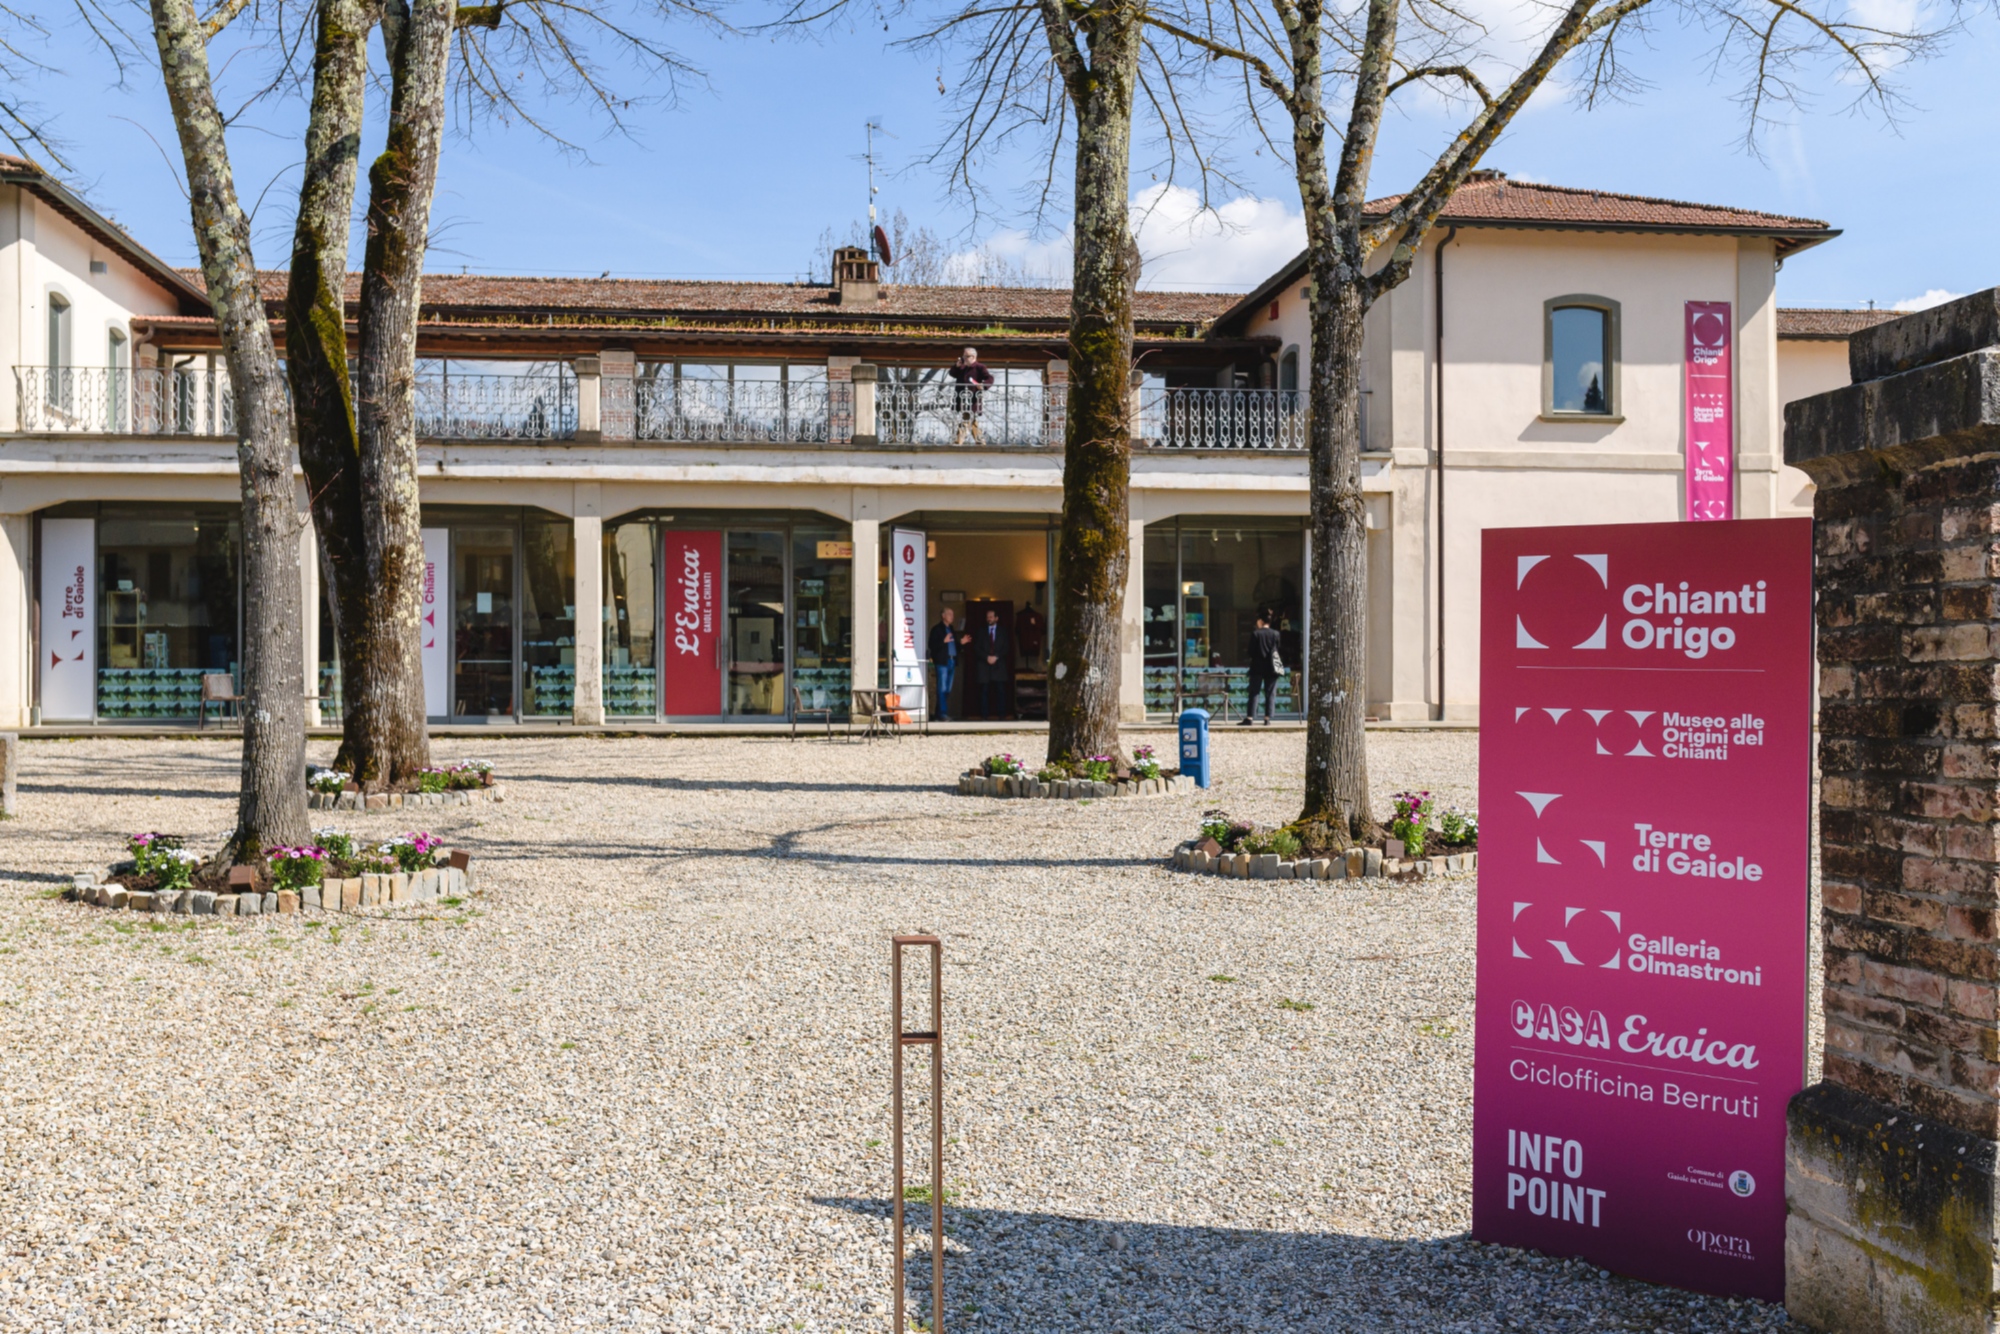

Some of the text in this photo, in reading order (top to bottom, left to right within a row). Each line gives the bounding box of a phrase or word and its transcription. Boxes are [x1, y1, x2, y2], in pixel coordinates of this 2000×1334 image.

[1693, 355, 1718, 366] Origo
[74, 565, 84, 619] di Gaiole
[424, 562, 435, 604] Chianti
[703, 572, 712, 600] CHIANTI
[903, 570, 915, 612] POINT
[1622, 580, 1767, 615] Chianti
[62, 586, 73, 618] Terre
[675, 548, 700, 656] L'Eroica
[703, 608, 712, 633] GAIOLE
[903, 617, 915, 649] INFO
[1622, 616, 1736, 659] Origo
[1663, 711, 1765, 730] Museo alle
[1662, 727, 1763, 747] Origini del
[1662, 743, 1728, 760] Chianti
[1634, 823, 1711, 852] Terre
[1632, 848, 1763, 882] di Gaiole
[1628, 933, 1720, 961] Galleria
[1628, 953, 1761, 986] Olmastroni
[1510, 999, 1759, 1070] CASA Eroica
[1509, 1059, 1759, 1119] Ciclofficina Berruti
[1508, 1129, 1583, 1179] INFO
[1667, 1172, 1724, 1189] Gaiole in Chianti
[1687, 1165, 1724, 1179] Comune di
[1507, 1172, 1606, 1228] POINT
[1687, 1228, 1752, 1254] opera
[1708, 1247, 1755, 1261] LABORATORI
